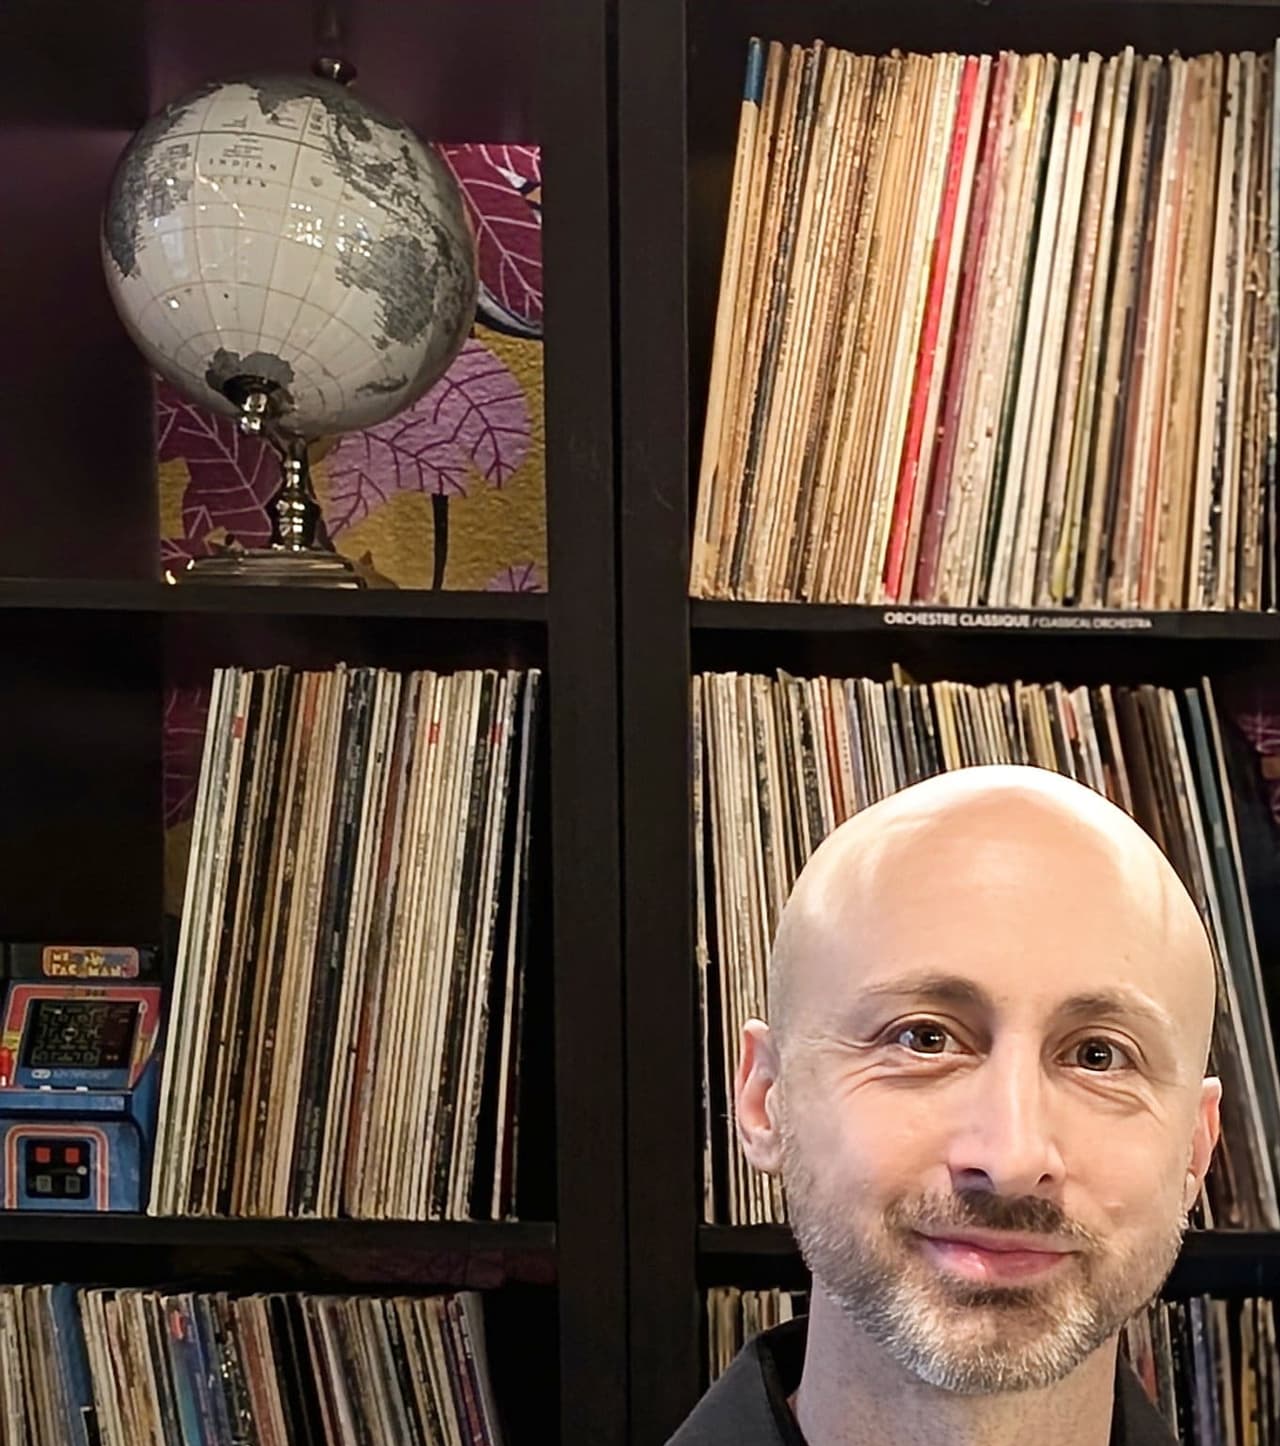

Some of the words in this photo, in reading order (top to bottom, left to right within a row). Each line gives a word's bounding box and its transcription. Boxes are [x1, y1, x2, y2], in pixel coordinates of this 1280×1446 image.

[209, 157, 277, 171] INDIAN
[884, 612, 957, 626] ORCHESTRE
[959, 613, 1030, 628] CLASSIQUE
